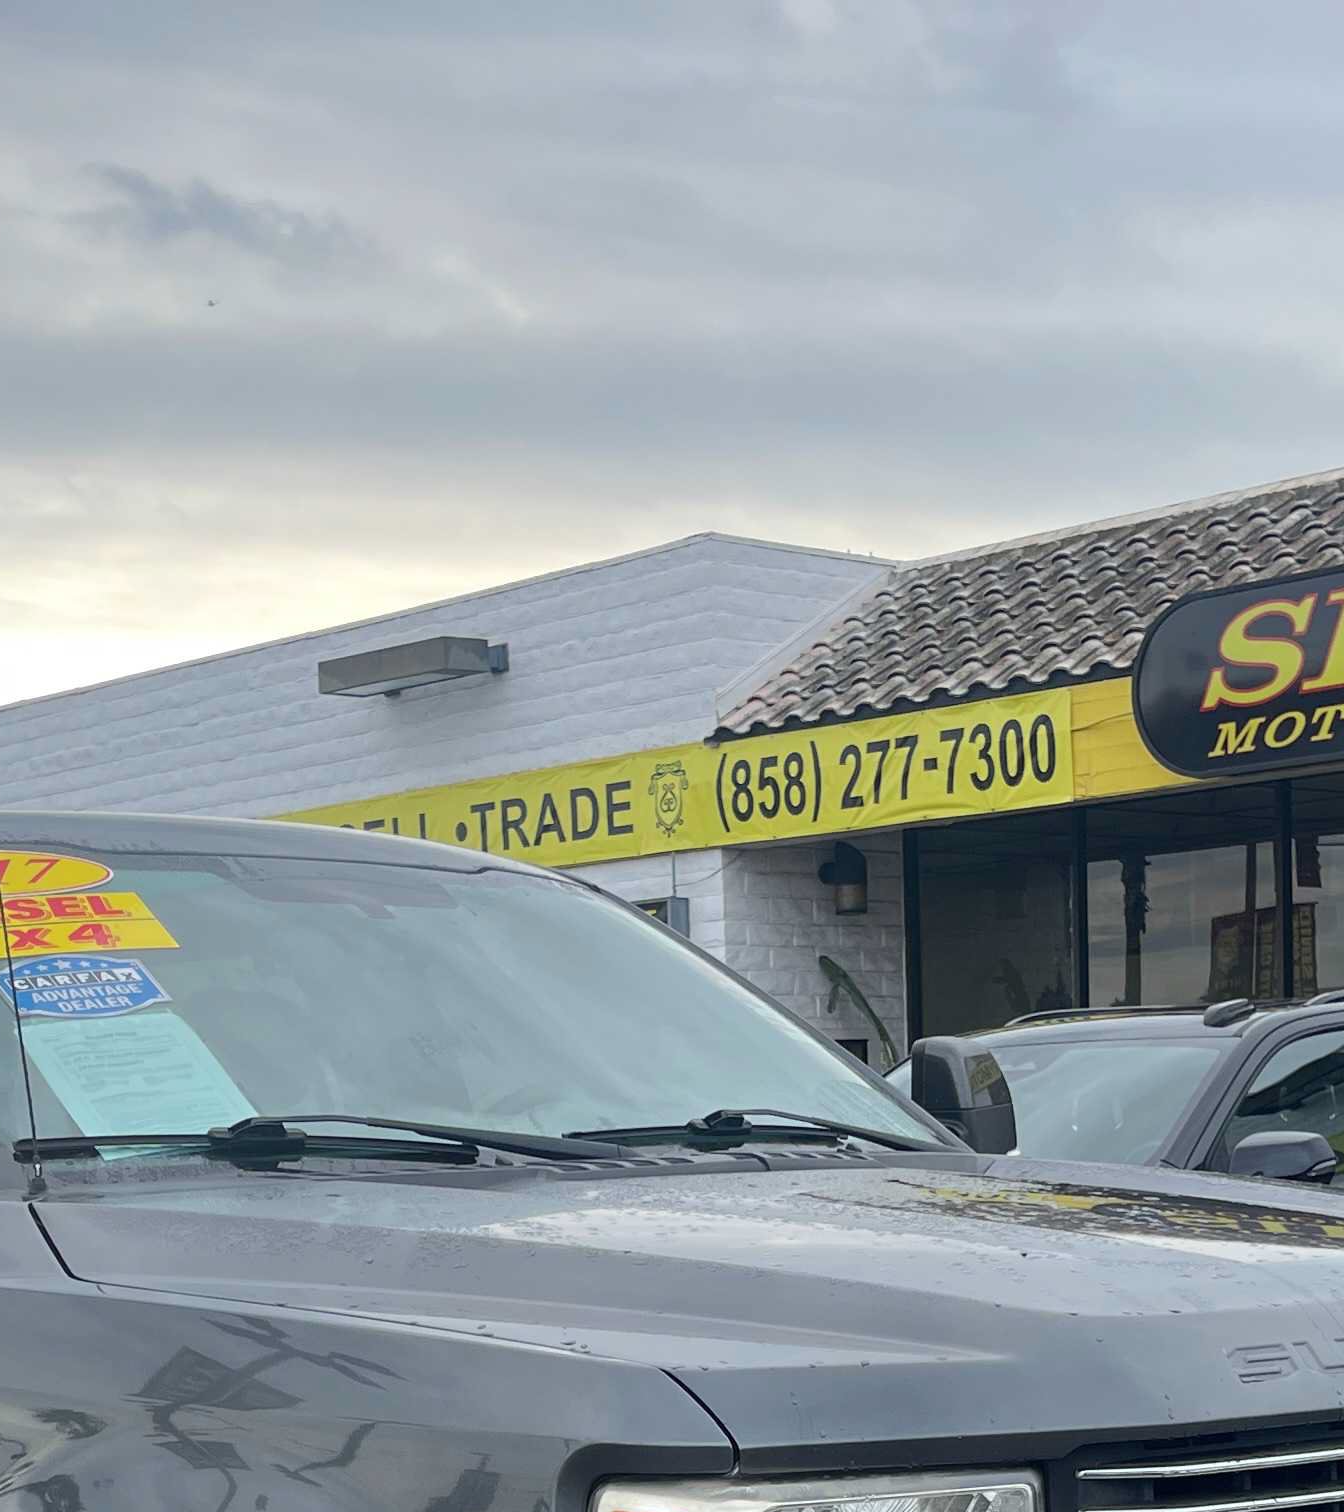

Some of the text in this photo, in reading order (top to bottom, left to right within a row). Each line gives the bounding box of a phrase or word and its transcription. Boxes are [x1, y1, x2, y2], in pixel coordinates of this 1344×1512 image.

[715, 713, 1057, 833] (858) 277-7300
[14, 969, 142, 990] CARFAX
[32, 983, 143, 1003] ADVANTAGE
[58, 996, 133, 1012] DEALER
